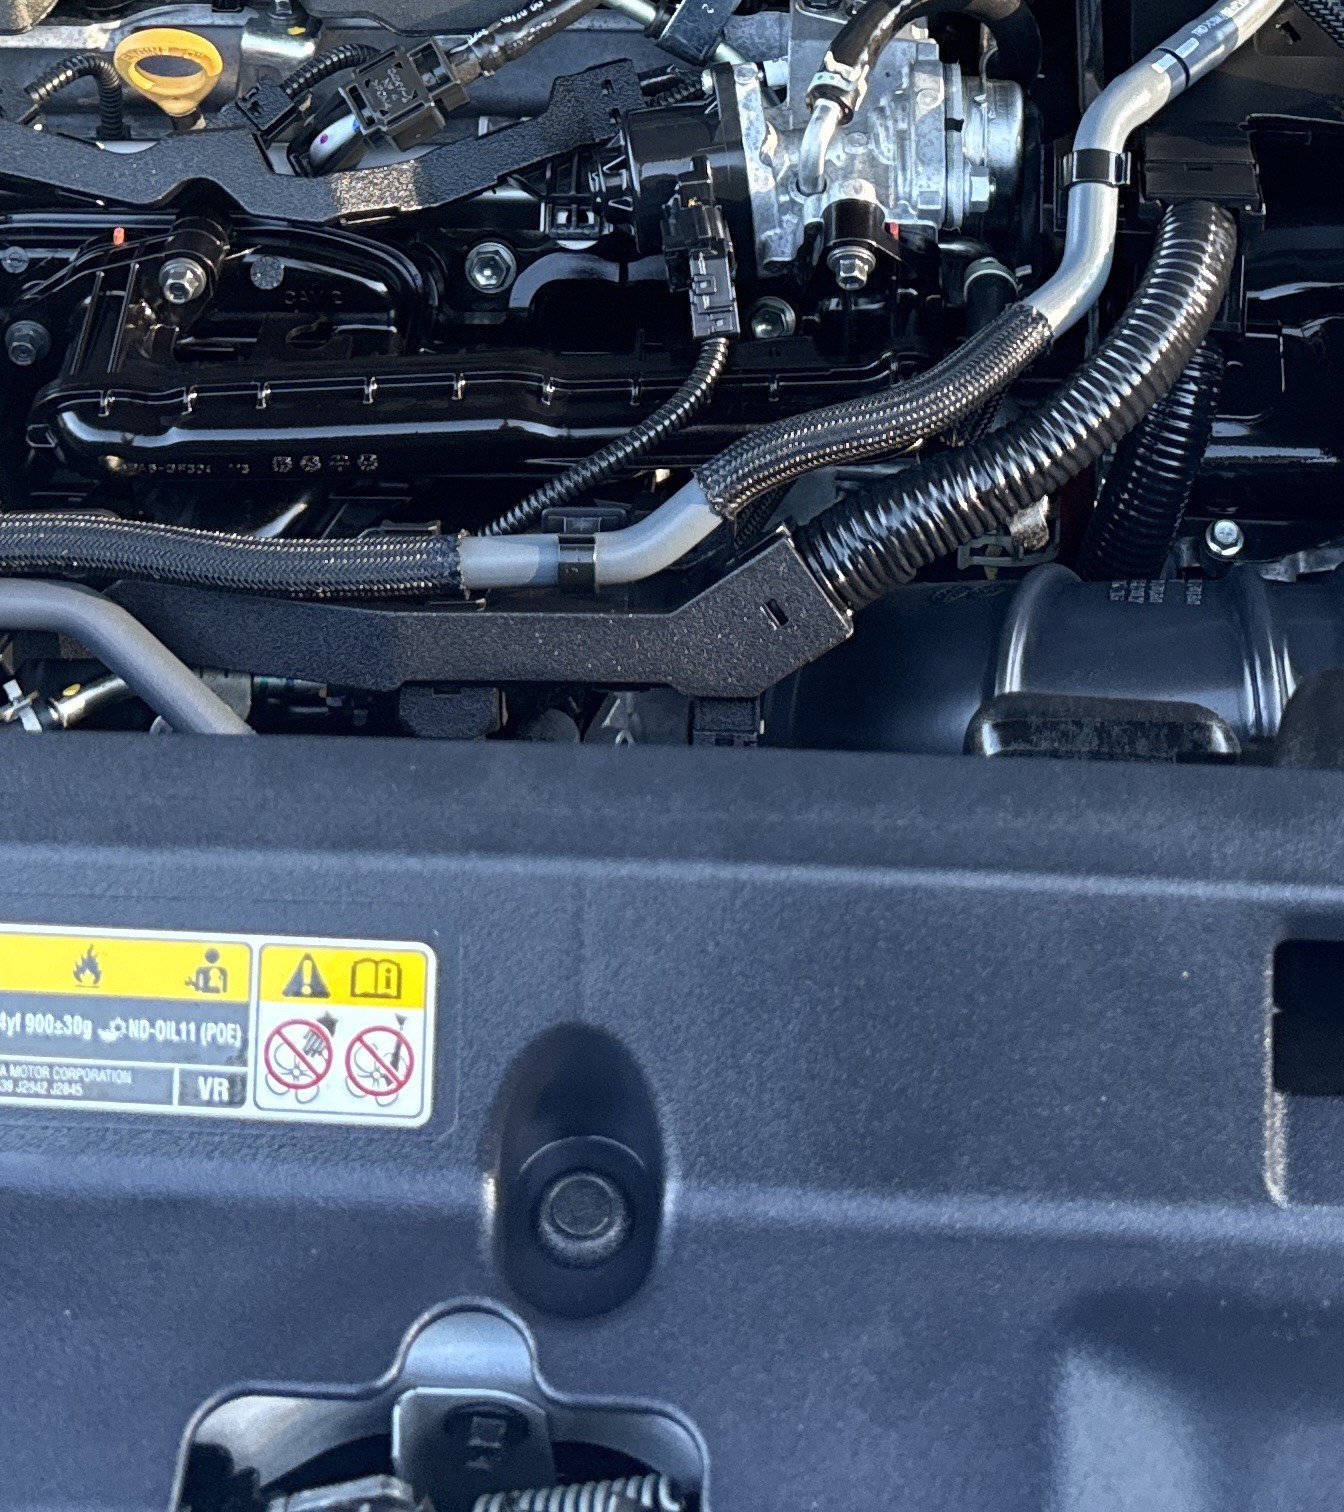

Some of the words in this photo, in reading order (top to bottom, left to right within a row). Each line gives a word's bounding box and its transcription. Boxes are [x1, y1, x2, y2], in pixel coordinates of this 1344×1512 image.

[25, 1014, 92, 1039] 900±30g
[129, 1022, 196, 1042] ND-OIL11
[200, 1023, 242, 1048] (POE)
[10, 1063, 50, 1079] MOTOR
[52, 1066, 133, 1085] CORPORATION
[197, 1076, 230, 1101] VR
